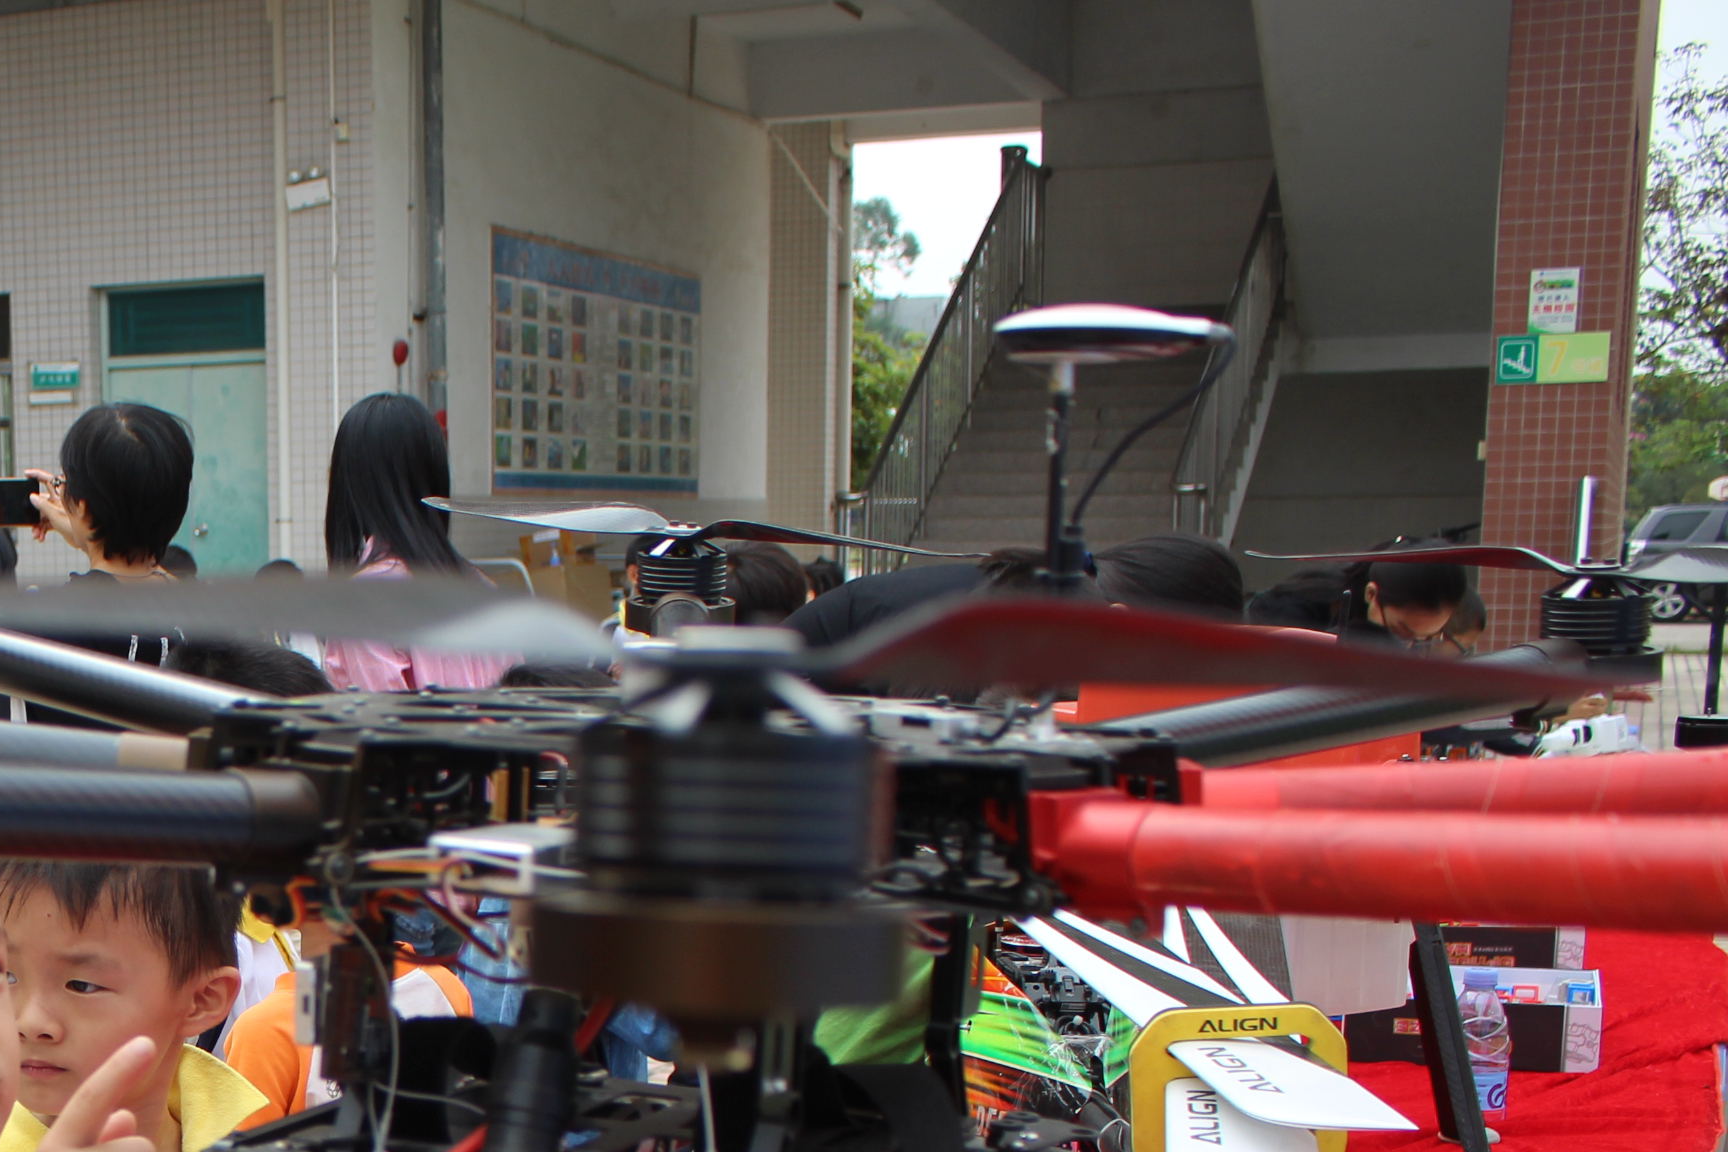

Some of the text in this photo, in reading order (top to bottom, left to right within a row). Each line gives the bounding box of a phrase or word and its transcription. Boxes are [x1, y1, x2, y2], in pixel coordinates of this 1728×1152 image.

[1546, 340, 1569, 376] 7
[1198, 1017, 1278, 1033] ALIGN
[1197, 1046, 1285, 1094] ALIGN
[1186, 1090, 1222, 1145] ALIGN
